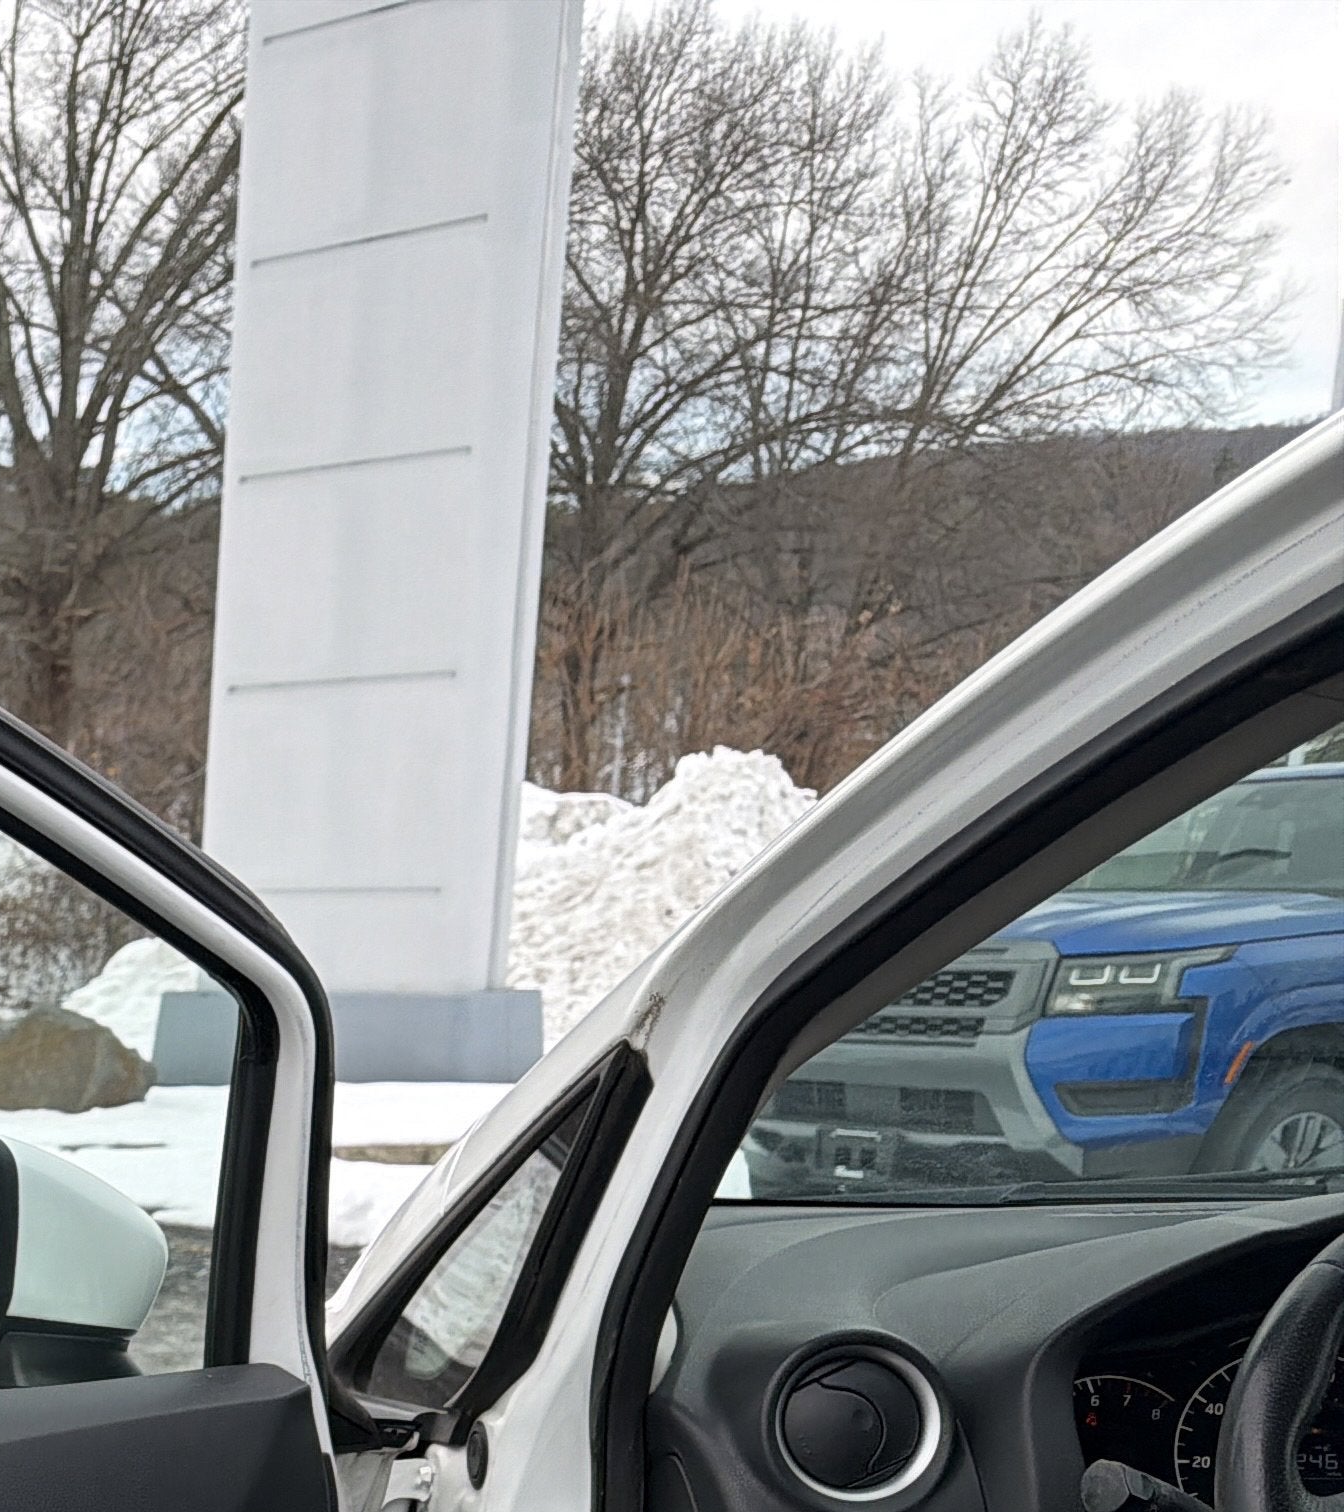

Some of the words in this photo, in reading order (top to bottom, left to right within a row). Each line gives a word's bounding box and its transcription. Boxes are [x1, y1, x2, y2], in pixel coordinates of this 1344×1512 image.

[1090, 1396, 1100, 1407] 6
[1123, 1395, 1132, 1407] 7
[1151, 1408, 1161, 1420] 8
[1204, 1403, 1224, 1416] 40
[1191, 1456, 1211, 1468] 20
